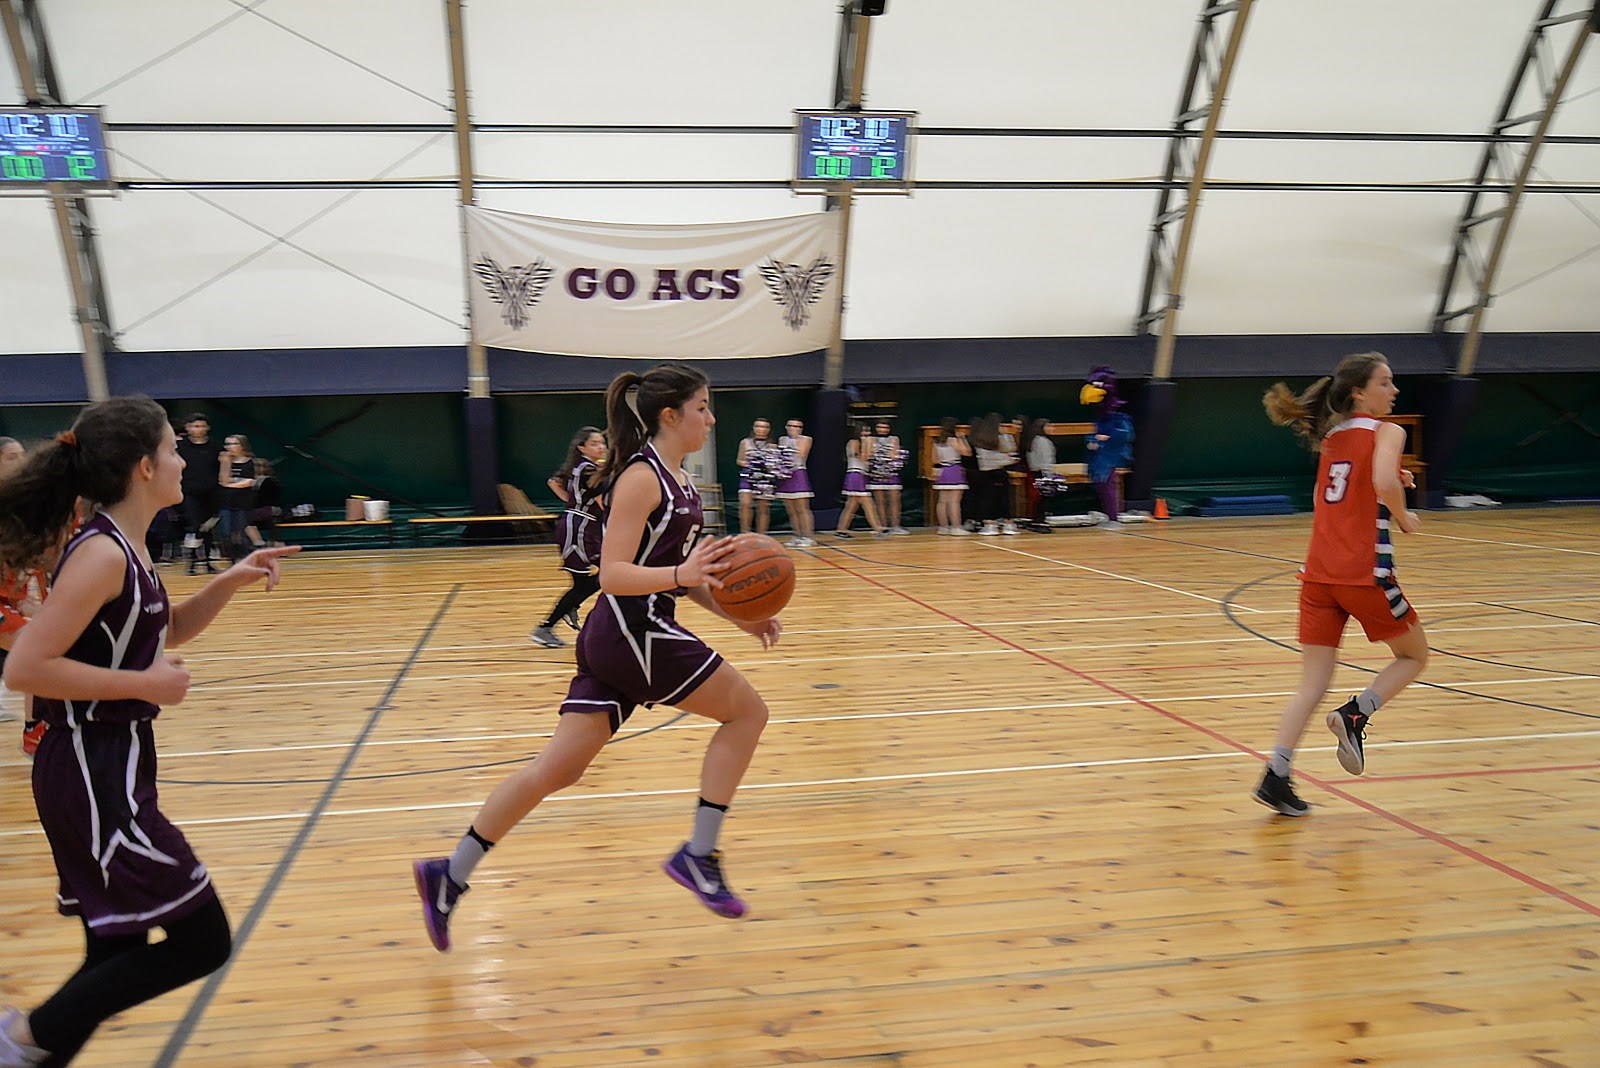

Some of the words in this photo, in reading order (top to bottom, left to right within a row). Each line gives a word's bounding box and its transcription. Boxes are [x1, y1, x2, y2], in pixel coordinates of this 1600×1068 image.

[567, 268, 636, 300] GO
[653, 268, 741, 301] ACS
[1324, 461, 1352, 504] 3
[682, 524, 700, 557] 5
